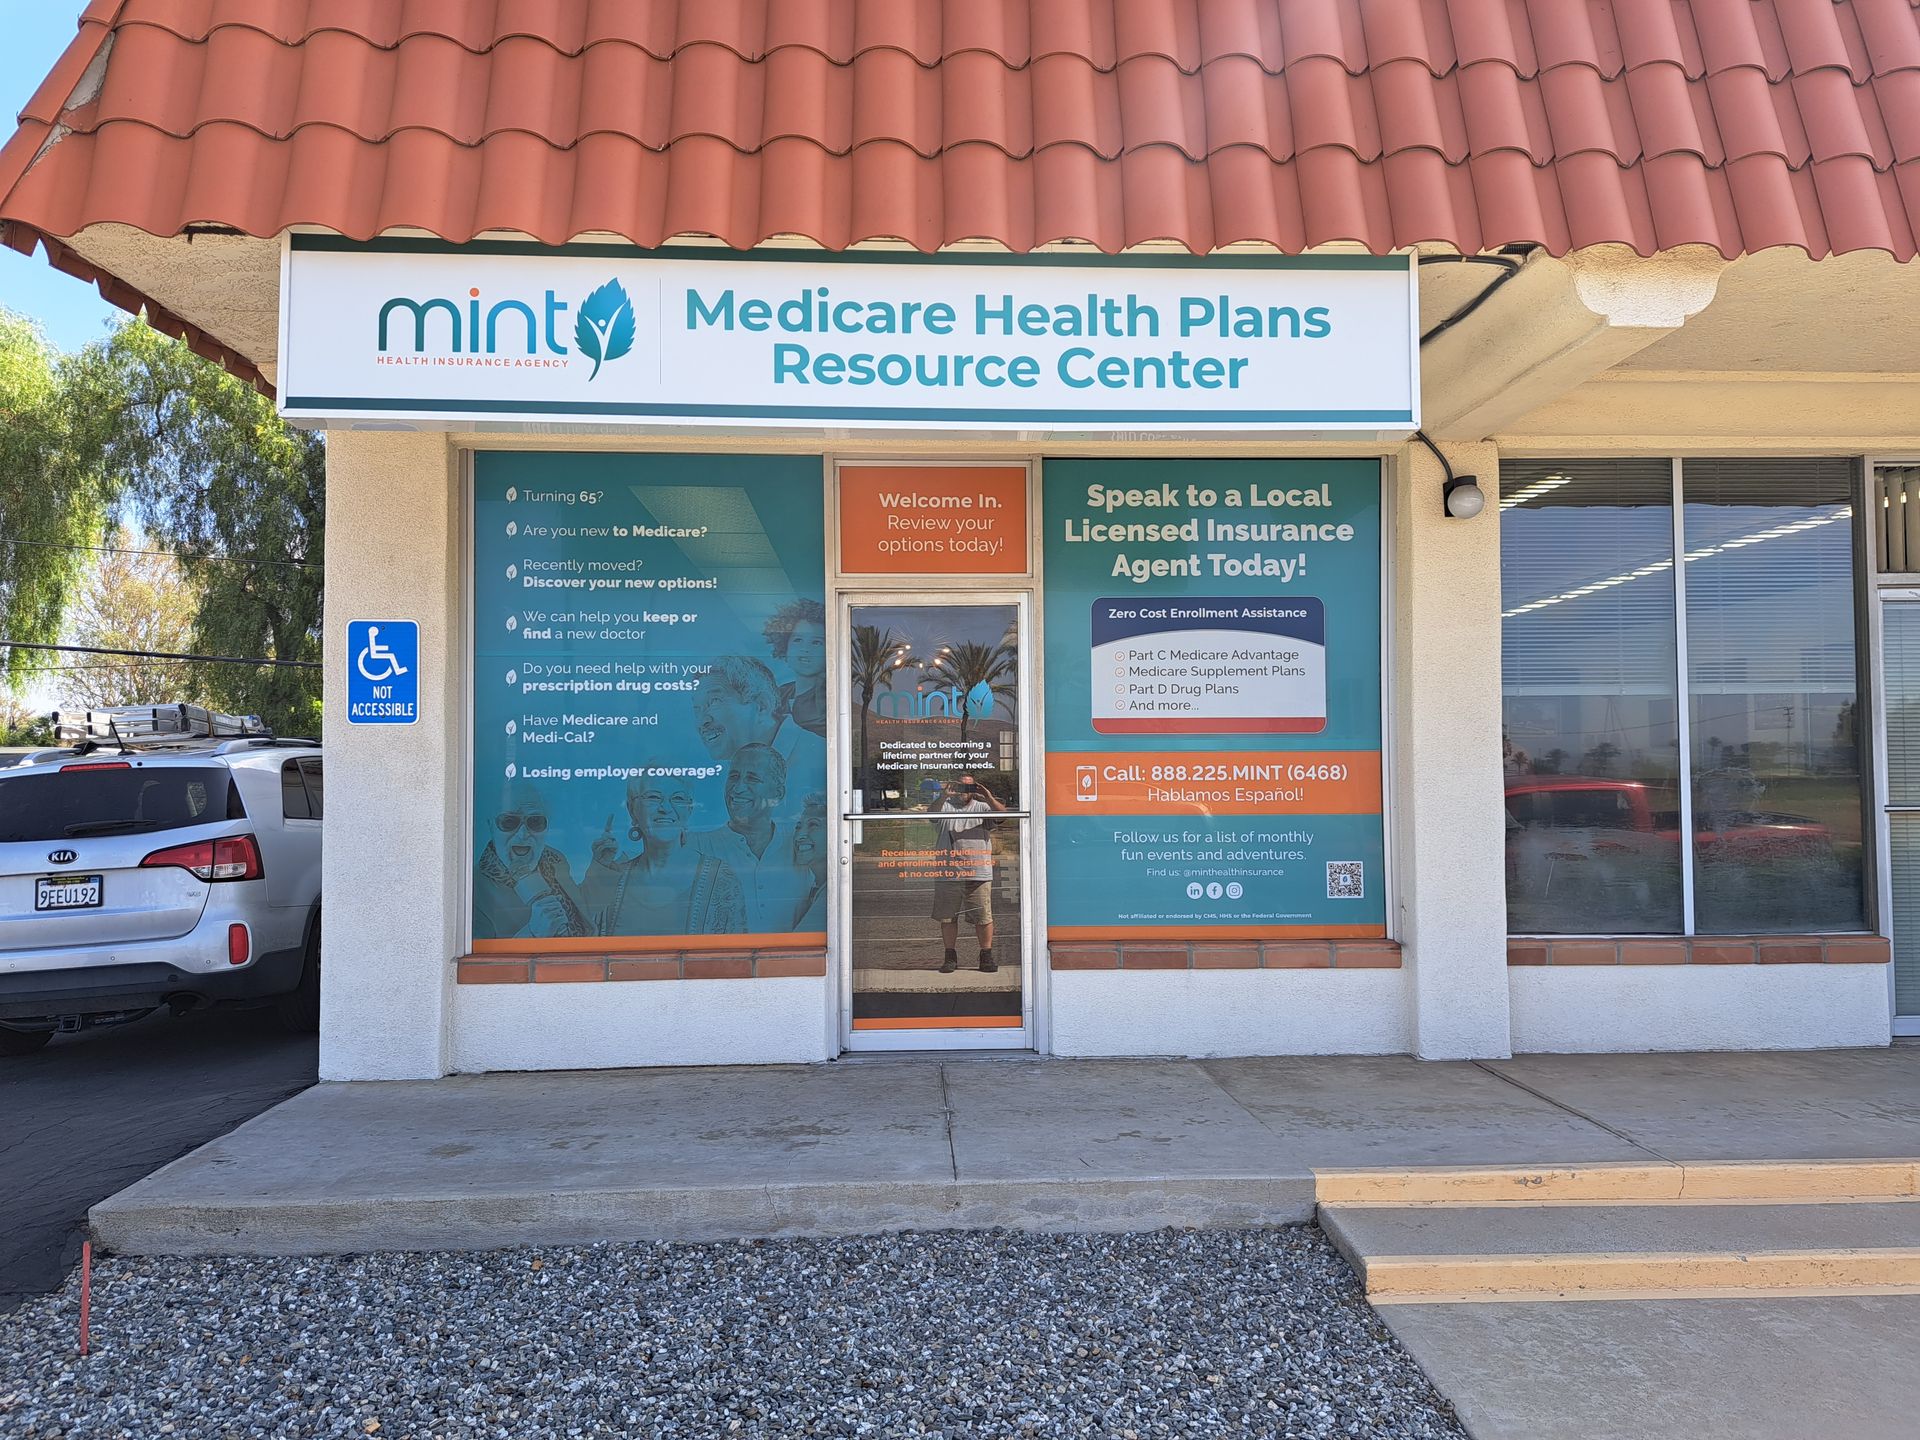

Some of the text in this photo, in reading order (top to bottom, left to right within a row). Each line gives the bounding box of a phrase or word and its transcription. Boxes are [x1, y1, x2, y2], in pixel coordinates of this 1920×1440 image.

[686, 287, 1331, 338] Medicare Health Plans
[378, 287, 568, 355] mint
[377, 356, 568, 368] HEALTH INSURANCE AGENCY
[774, 343, 1249, 389] Resource Center
[523, 490, 603, 505] Turning 65?
[878, 492, 1002, 508] Welcome In.
[1087, 484, 1332, 513] Speak to a Local
[888, 515, 995, 534] Review your
[1065, 518, 1354, 542] Licensed Insurance
[523, 525, 707, 539] Are you new to Medicare?
[878, 536, 1003, 556] options today!
[523, 559, 643, 573] Recently moved?
[1111, 553, 1306, 584] Agent Today!
[523, 577, 717, 591] Discover your new options!
[523, 611, 697, 625] We can help you keep or
[1109, 607, 1307, 619] Zero Cost Enrollment Assistance
[523, 628, 645, 640] find a new doctor
[1129, 650, 1299, 663] Part C Medicare Advantage
[523, 662, 712, 677] Do you need help with your
[1129, 666, 1305, 679] Medicare Supplement Plans
[373, 686, 392, 700] NOT
[523, 679, 700, 693] prescription drug costs?
[1129, 683, 1239, 697] Part D Drug Plans
[876, 685, 963, 718] mint
[1129, 700, 1199, 711] And more...
[352, 701, 414, 717] ACCESSIBLE
[523, 714, 658, 725] Have Medicare and
[523, 732, 594, 743] Medi-Cal?
[880, 741, 926, 749] Dedicated
[939, 740, 983, 750] becoming
[919, 752, 952, 760] partner
[523, 765, 721, 780] Losing employer coverage?
[877, 762, 918, 770] Medicare
[920, 762, 964, 770] Insurance
[1103, 764, 1348, 782] Call: 888.225.MINT (6468)
[1148, 787, 1304, 804] Hablamos Español!
[1114, 831, 1314, 845] Follow us for a list of monthly
[51, 852, 73, 861] KIA
[920, 849, 947, 858] expert
[950, 849, 992, 858] guida
[1121, 849, 1306, 861] fun events and adventures.
[878, 860, 895, 868] and
[899, 870, 908, 878] at
[1146, 868, 1166, 877] Find
[1183, 868, 1284, 878] @minthealthinsurance
[40, 888, 96, 905] 9EEU192
